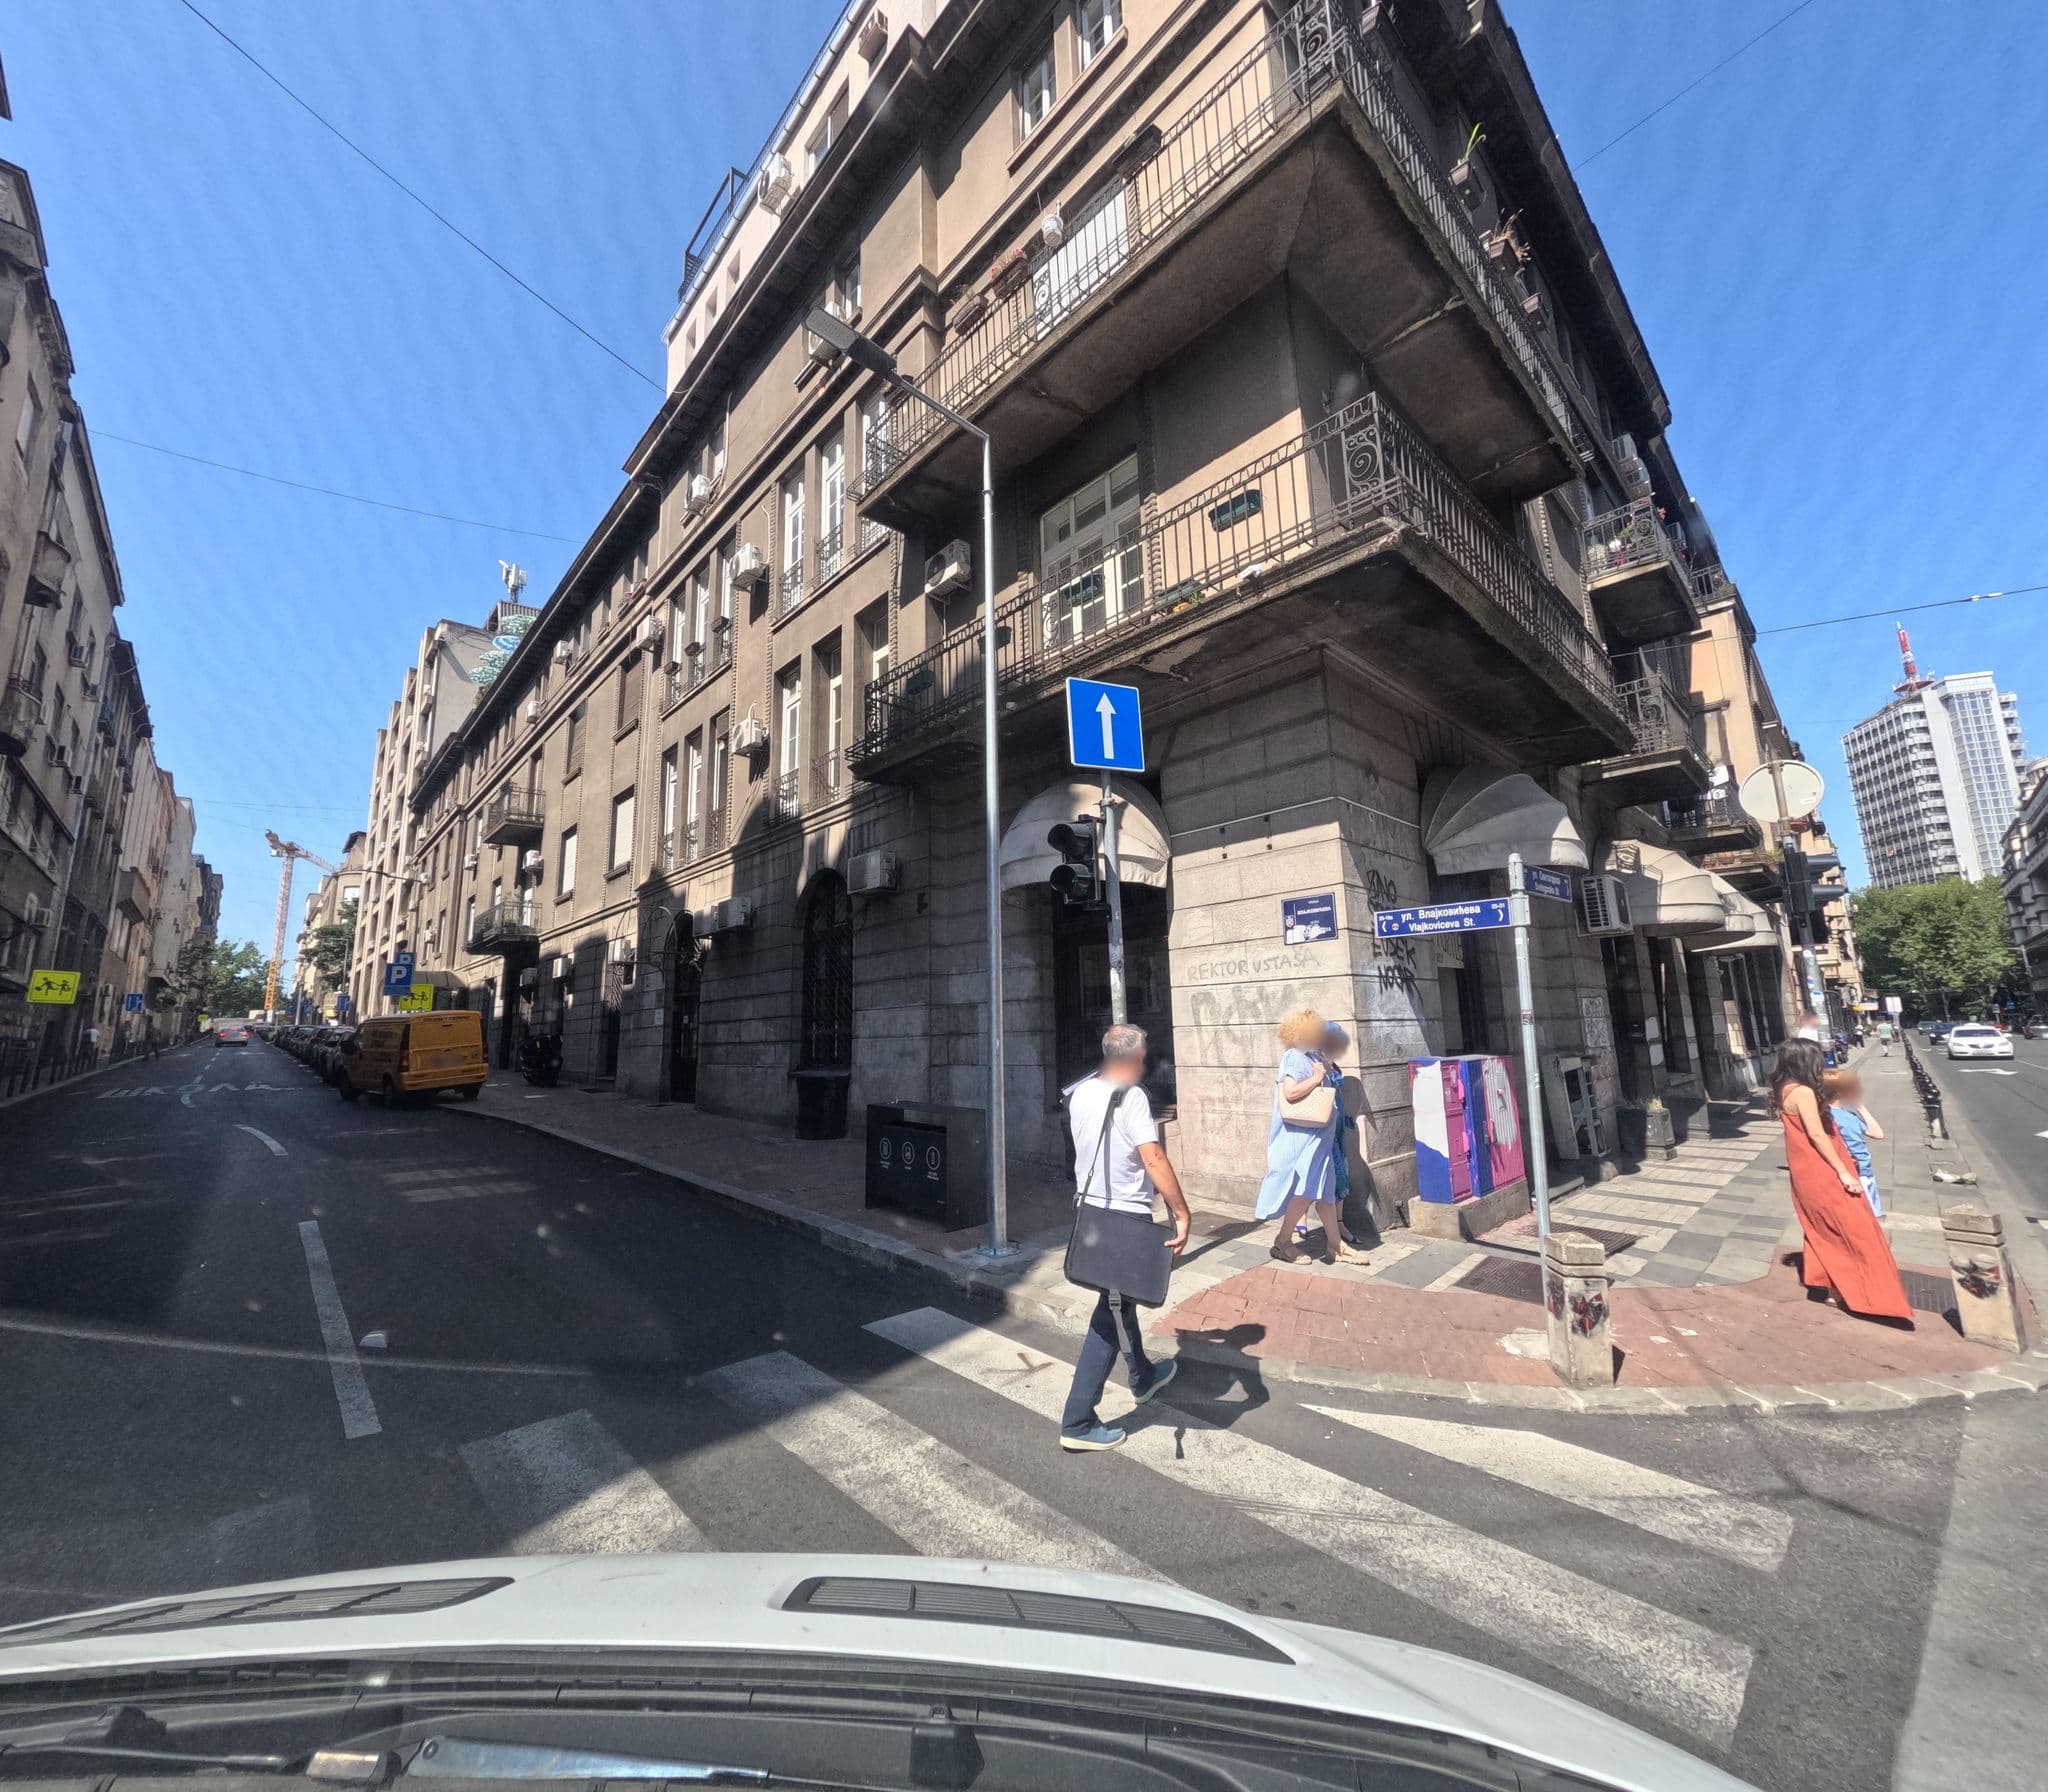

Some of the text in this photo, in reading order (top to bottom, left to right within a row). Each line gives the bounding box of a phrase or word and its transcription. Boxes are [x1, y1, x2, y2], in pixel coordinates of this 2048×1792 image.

[1401, 905, 1481, 923] ул. Влајковићева
[1463, 917, 1477, 927] St.
[391, 965, 407, 984] P
[1187, 959, 1249, 981] REKTOR
